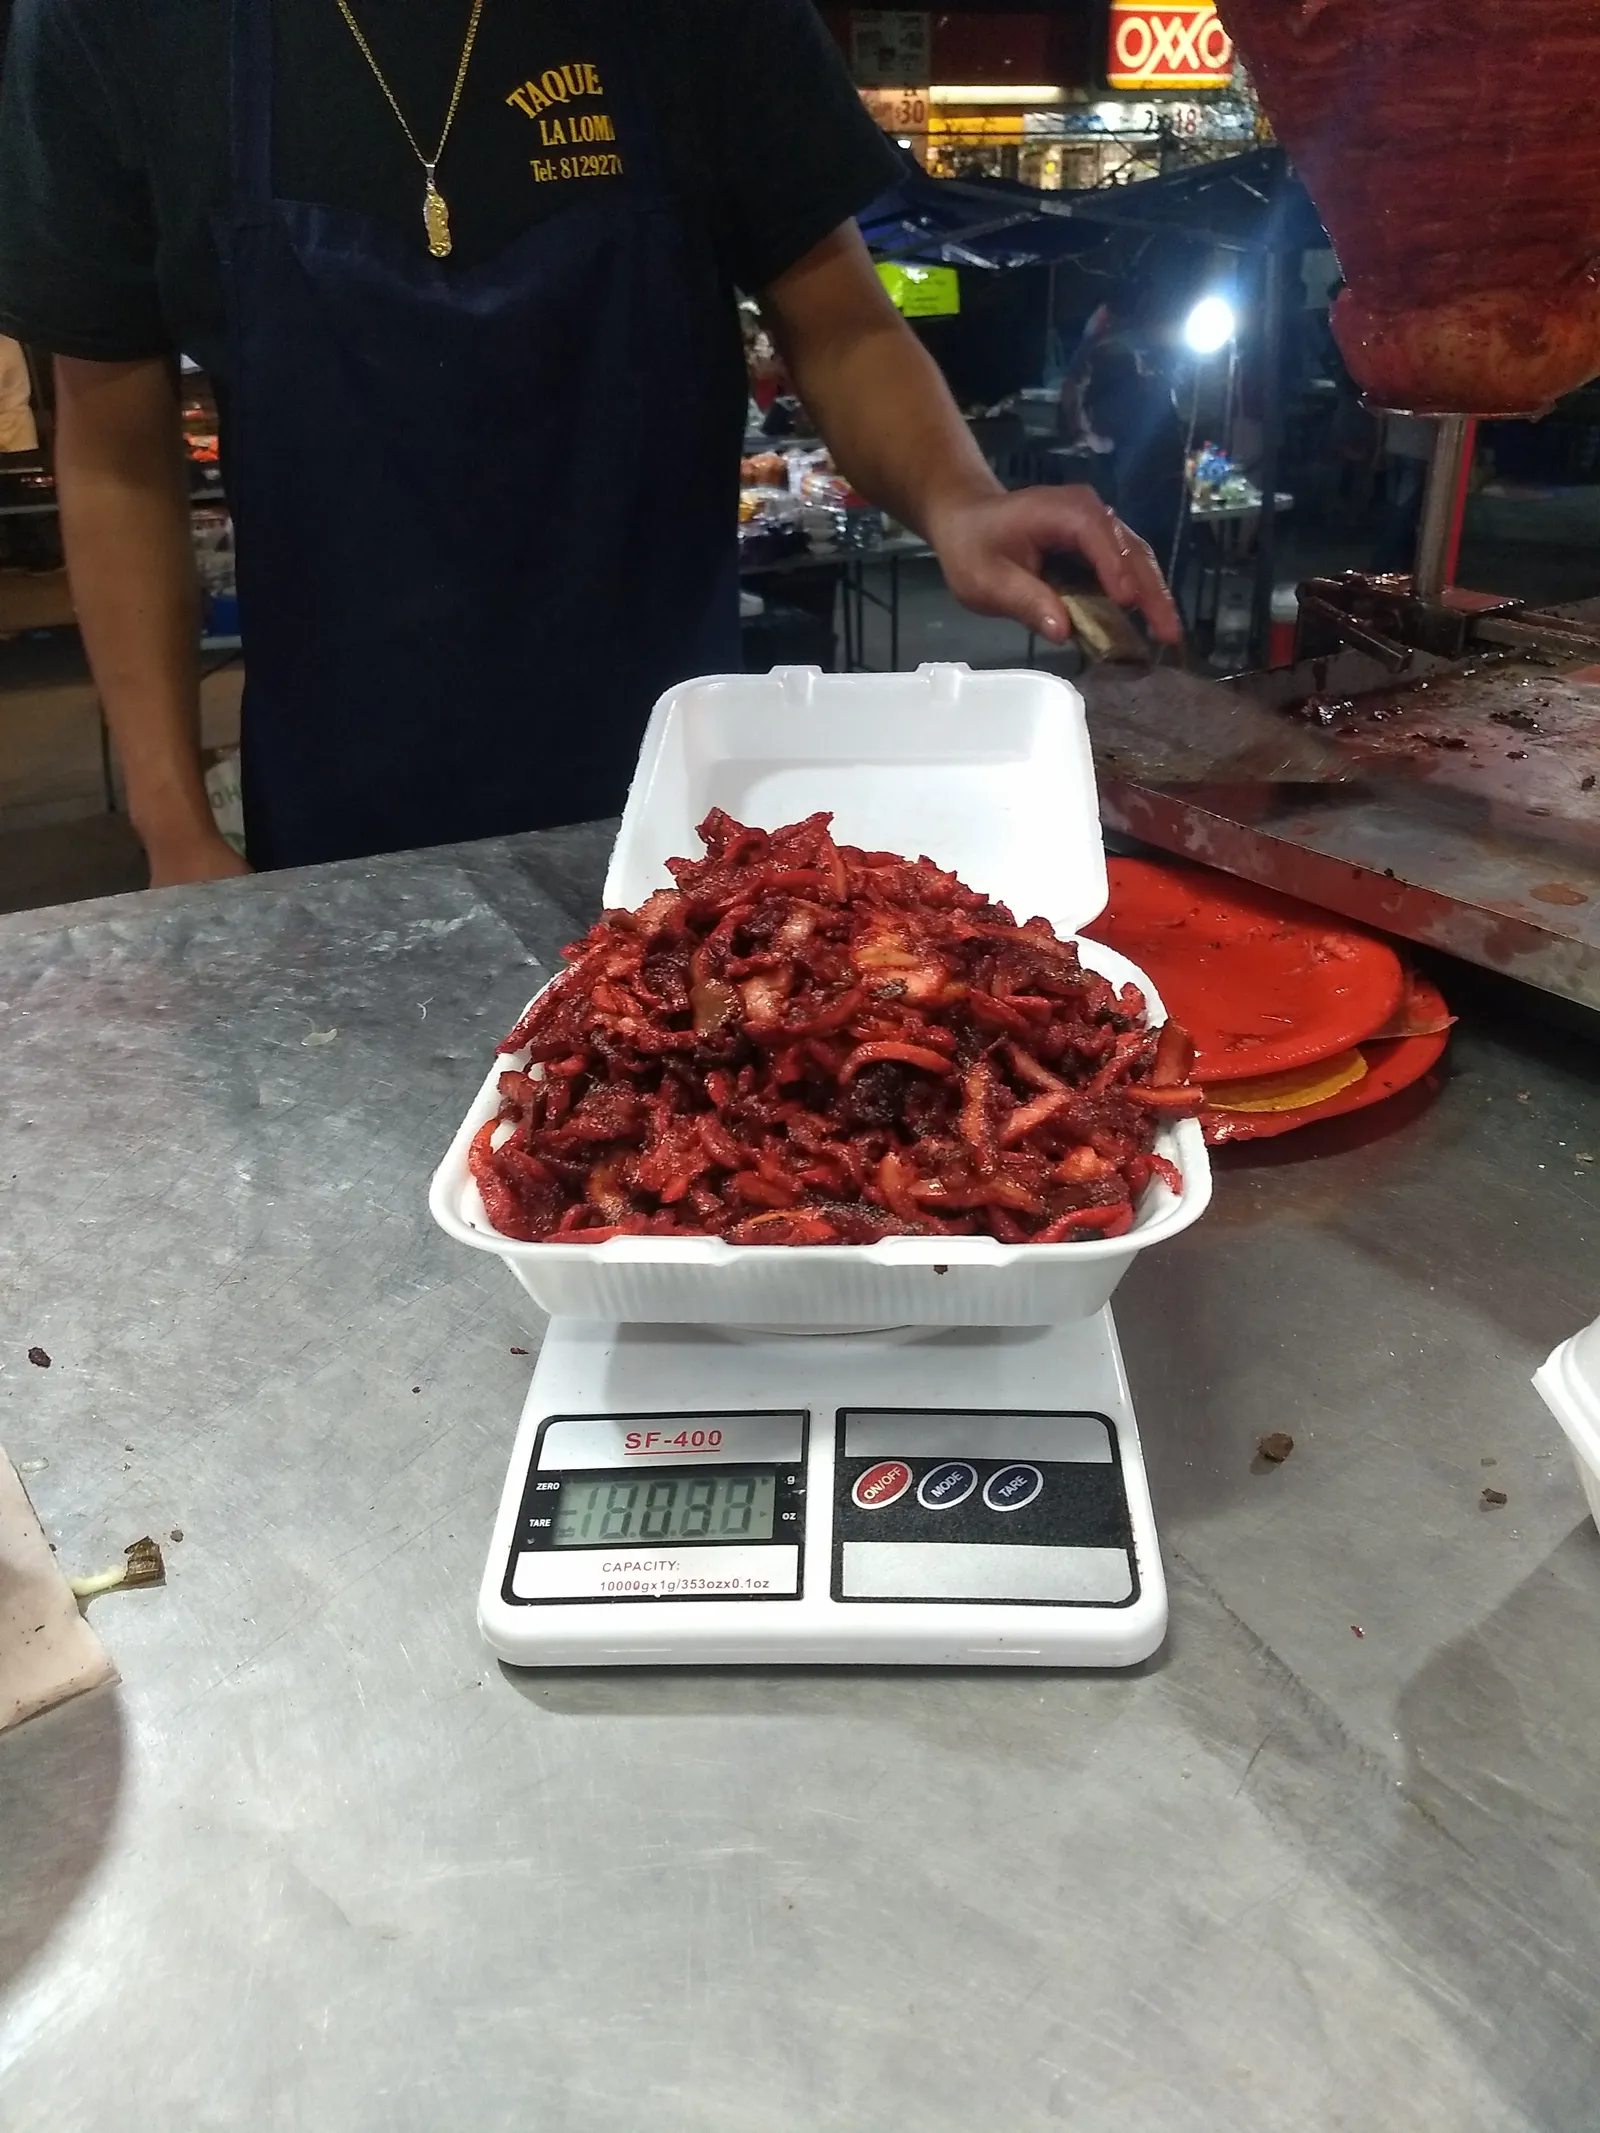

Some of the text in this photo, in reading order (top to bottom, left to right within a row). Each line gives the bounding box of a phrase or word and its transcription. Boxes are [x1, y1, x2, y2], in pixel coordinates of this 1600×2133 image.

[1116, 16, 1232, 74] OXXO
[506, 63, 603, 119] TAQUE
[539, 115, 616, 146] LA LOM
[529, 159, 559, 182] Tel:
[624, 1430, 723, 1450] SF-400
[536, 1482, 560, 1491] ZERO
[786, 1475, 795, 1485] g
[862, 1467, 901, 1501] ON/OFF
[930, 1470, 964, 1499] MODE
[998, 1474, 1028, 1499] TARE
[529, 1518, 552, 1527] TARE
[602, 1560, 681, 1573] CAPACITY:
[600, 1578, 771, 1593] 10000gx1g/353ozx0.1oz
